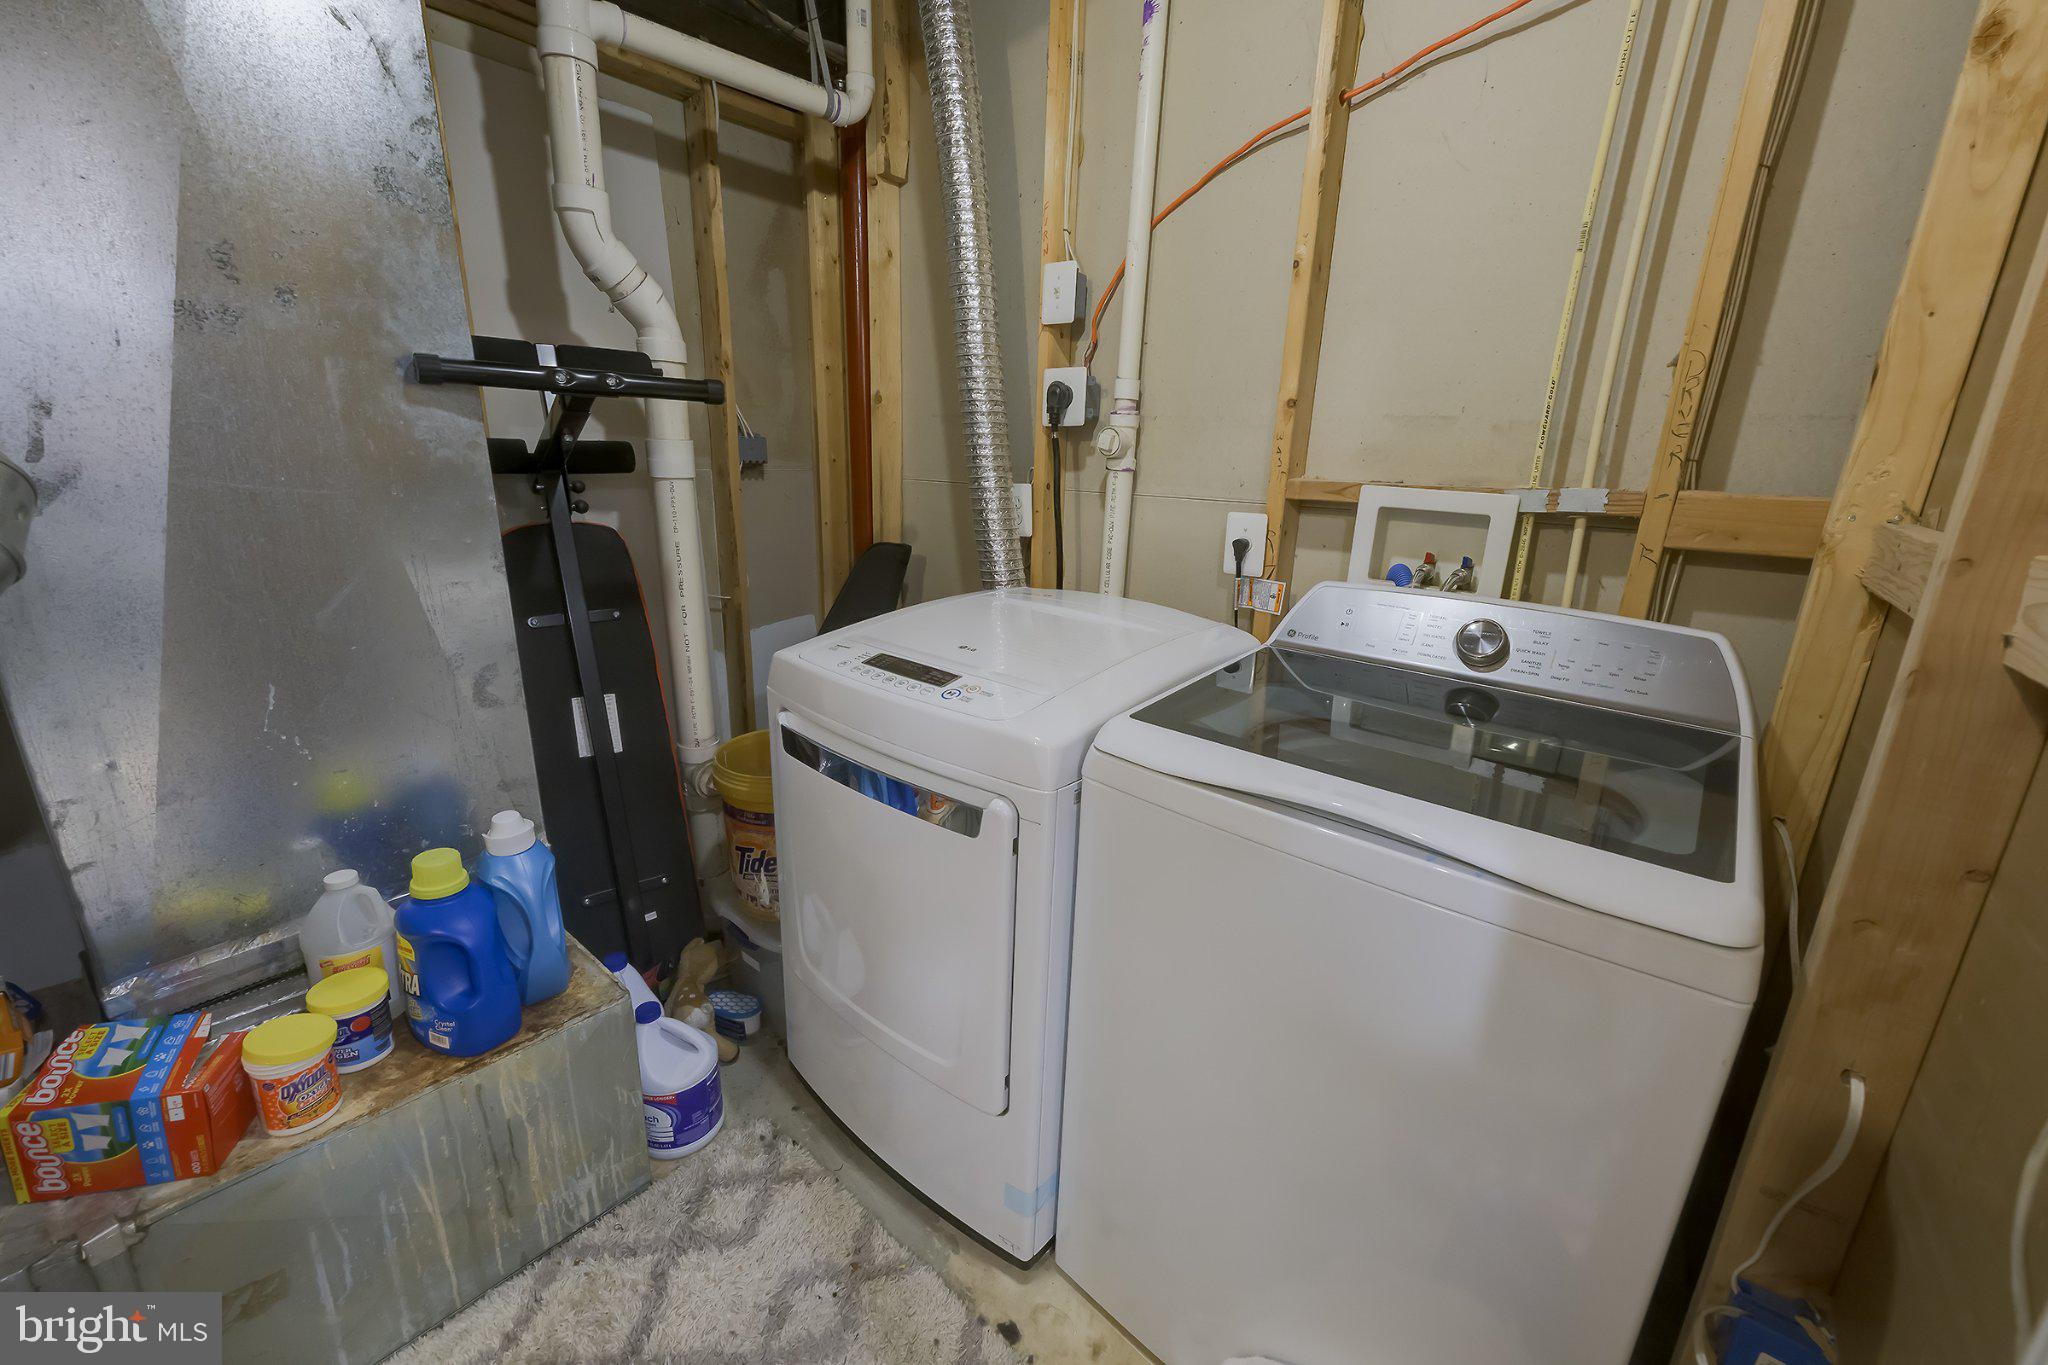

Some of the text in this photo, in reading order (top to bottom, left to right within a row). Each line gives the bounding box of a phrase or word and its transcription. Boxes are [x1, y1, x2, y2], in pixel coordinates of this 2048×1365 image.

[1615, 9, 1637, 86] CHARLOTTE
[676, 541, 686, 598] PRESSURE
[680, 604, 688, 625] FOR
[1297, 632, 1320, 641] Profile
[735, 845, 777, 876] Tide
[401, 967, 420, 996] TRA
[23, 1029, 84, 1105] bounce
[16, 1121, 68, 1193] bounce
